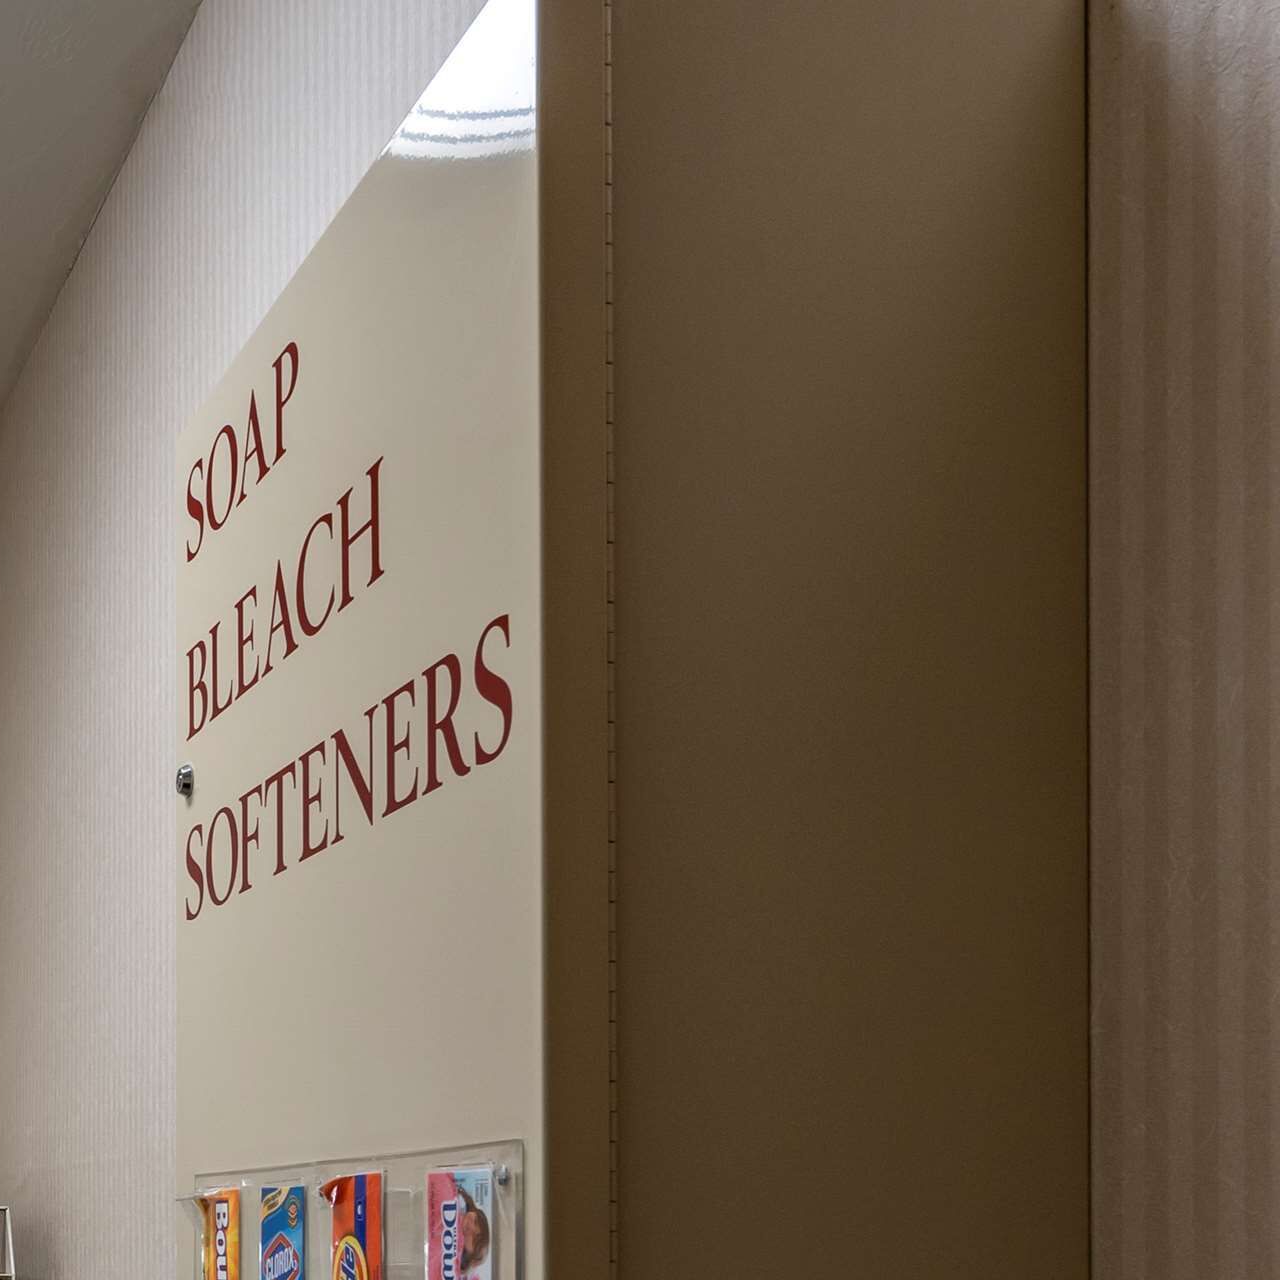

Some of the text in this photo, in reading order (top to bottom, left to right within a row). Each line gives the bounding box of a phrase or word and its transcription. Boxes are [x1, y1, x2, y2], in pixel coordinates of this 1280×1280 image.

[186, 341, 299, 562] SOAP
[186, 456, 384, 741] BLEACH
[185, 614, 513, 920] SOFTENERS
